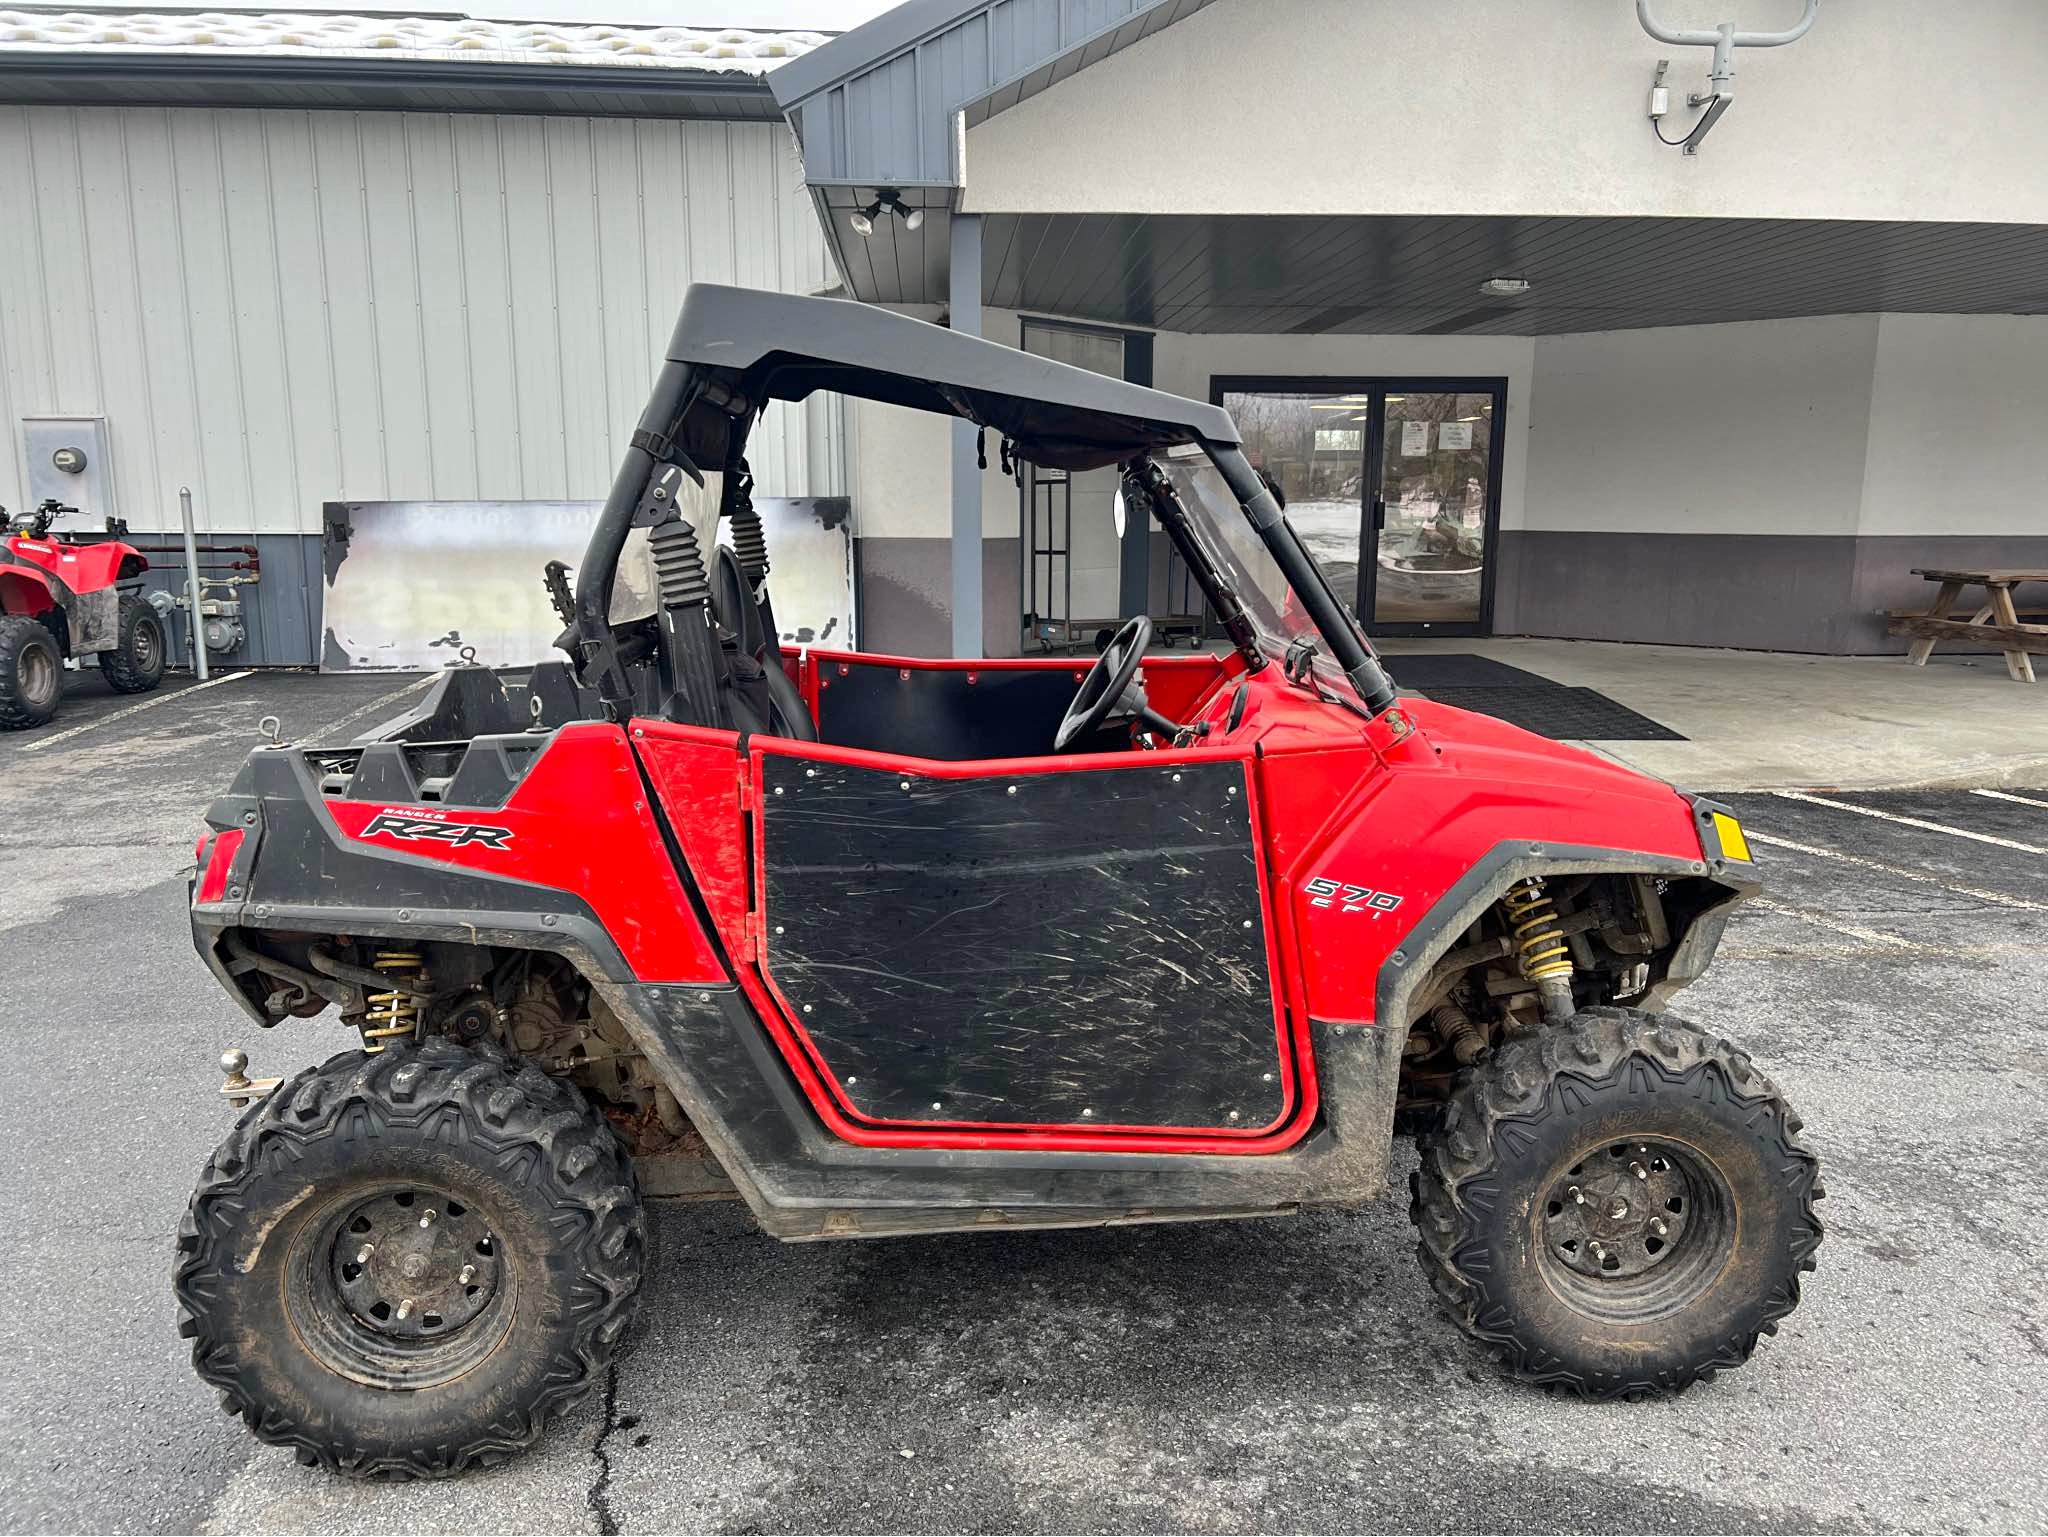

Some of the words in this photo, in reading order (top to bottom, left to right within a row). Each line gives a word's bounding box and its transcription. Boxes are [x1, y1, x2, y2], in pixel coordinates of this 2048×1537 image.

[383, 808, 447, 820] RANGER
[360, 815, 514, 850] RZR
[1305, 877, 1402, 911] 570
[1311, 897, 1381, 919] EFI
